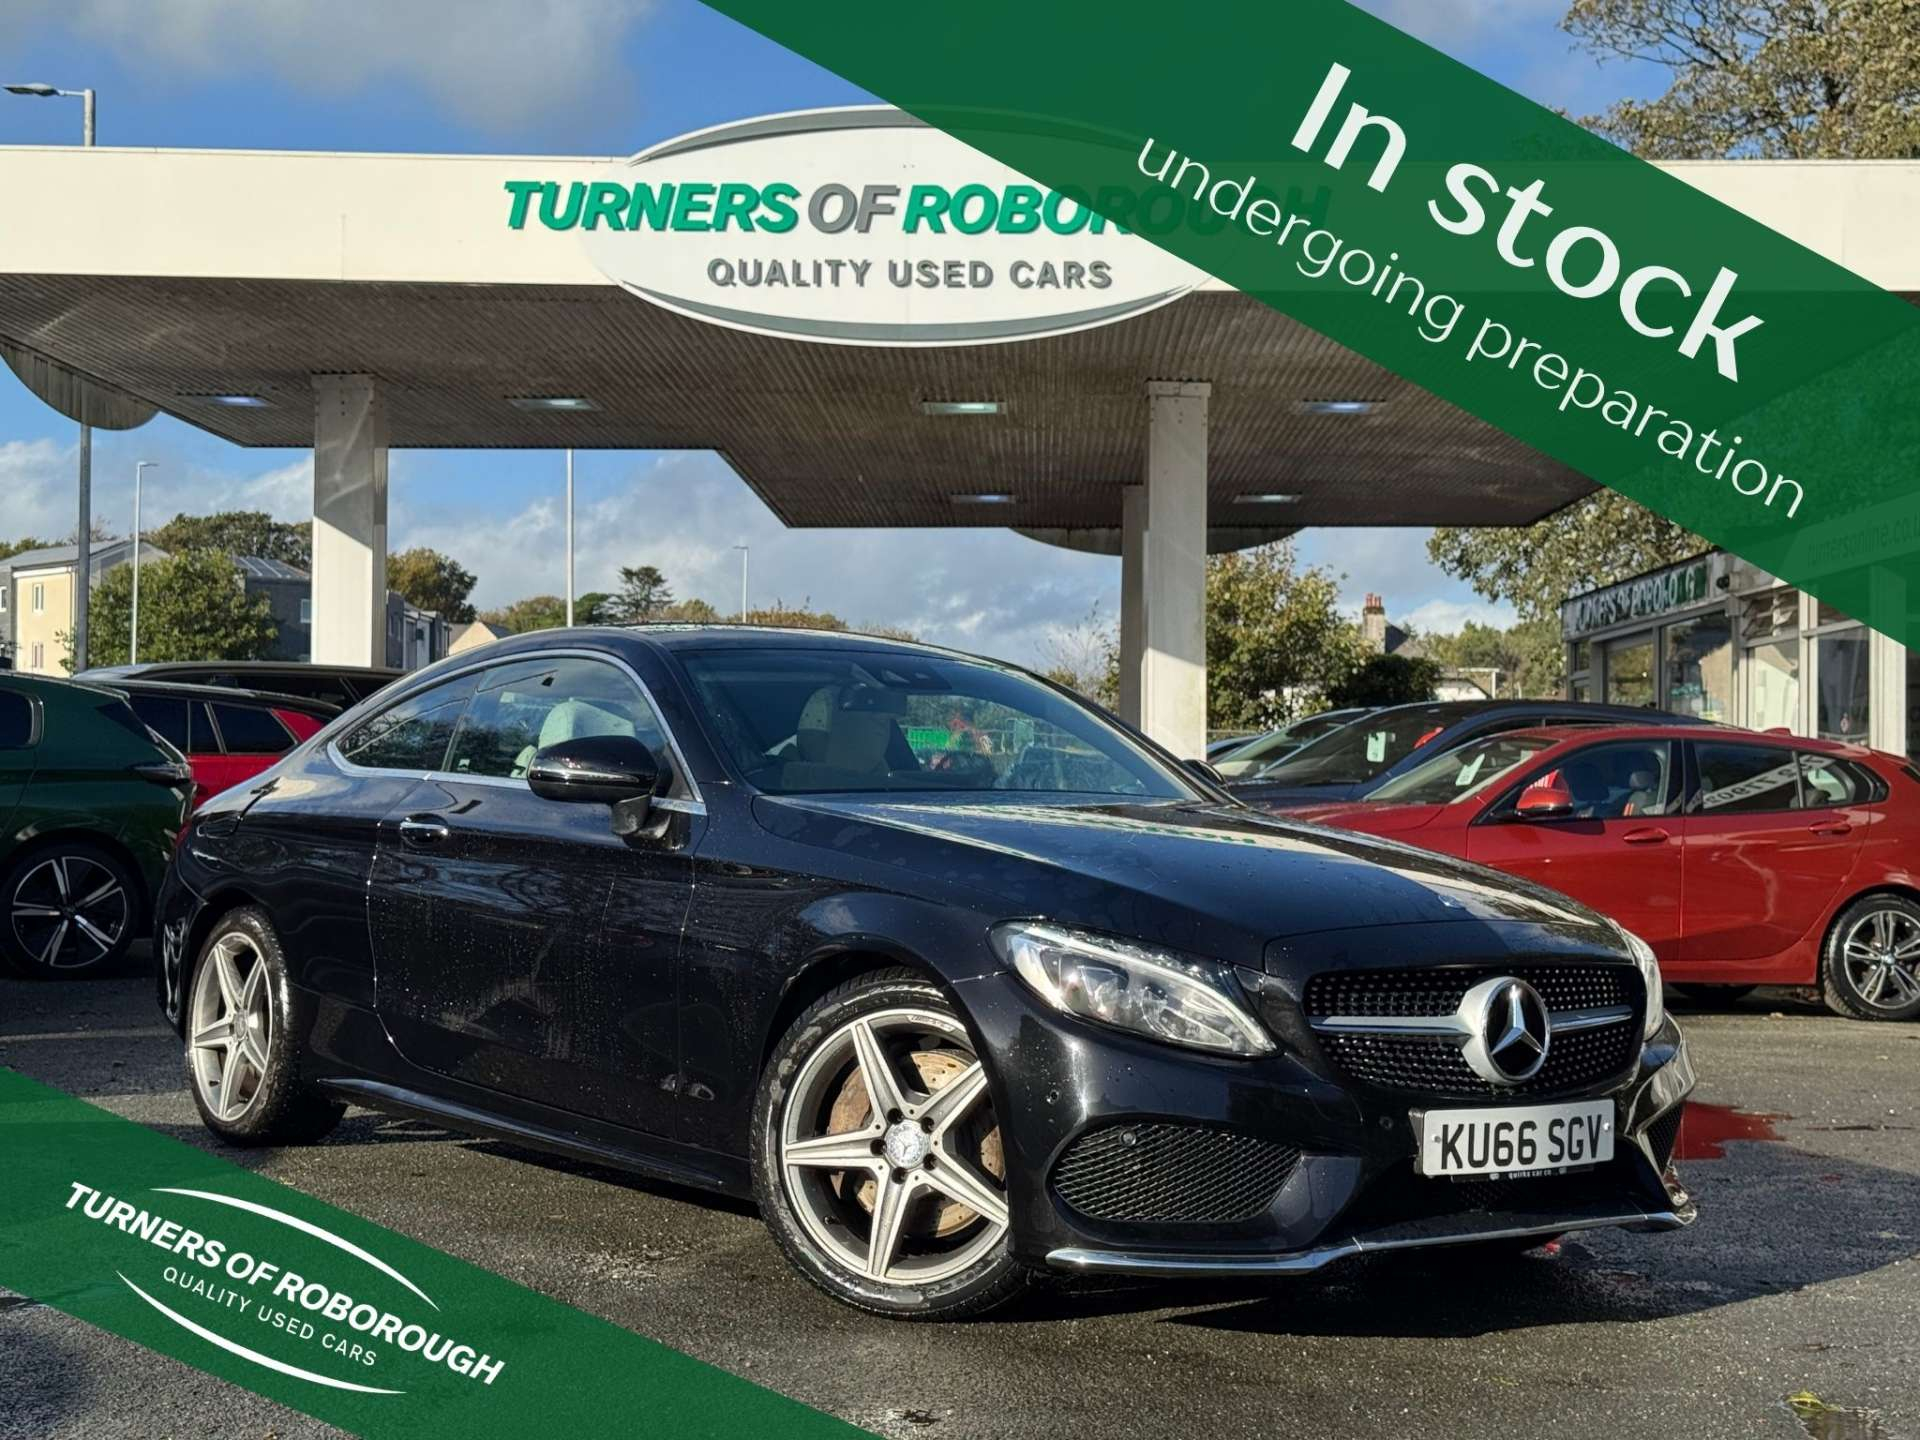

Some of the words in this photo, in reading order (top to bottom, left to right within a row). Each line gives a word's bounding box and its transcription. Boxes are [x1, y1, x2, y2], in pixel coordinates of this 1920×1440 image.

[503, 180, 803, 234] TURNERS
[807, 182, 902, 234] OF
[706, 257, 873, 289] QUALITY
[888, 259, 994, 289] USED
[1009, 259, 1113, 290] CARS
[1440, 1122, 1538, 1170] KU66
[1547, 1114, 1603, 1163] SGV
